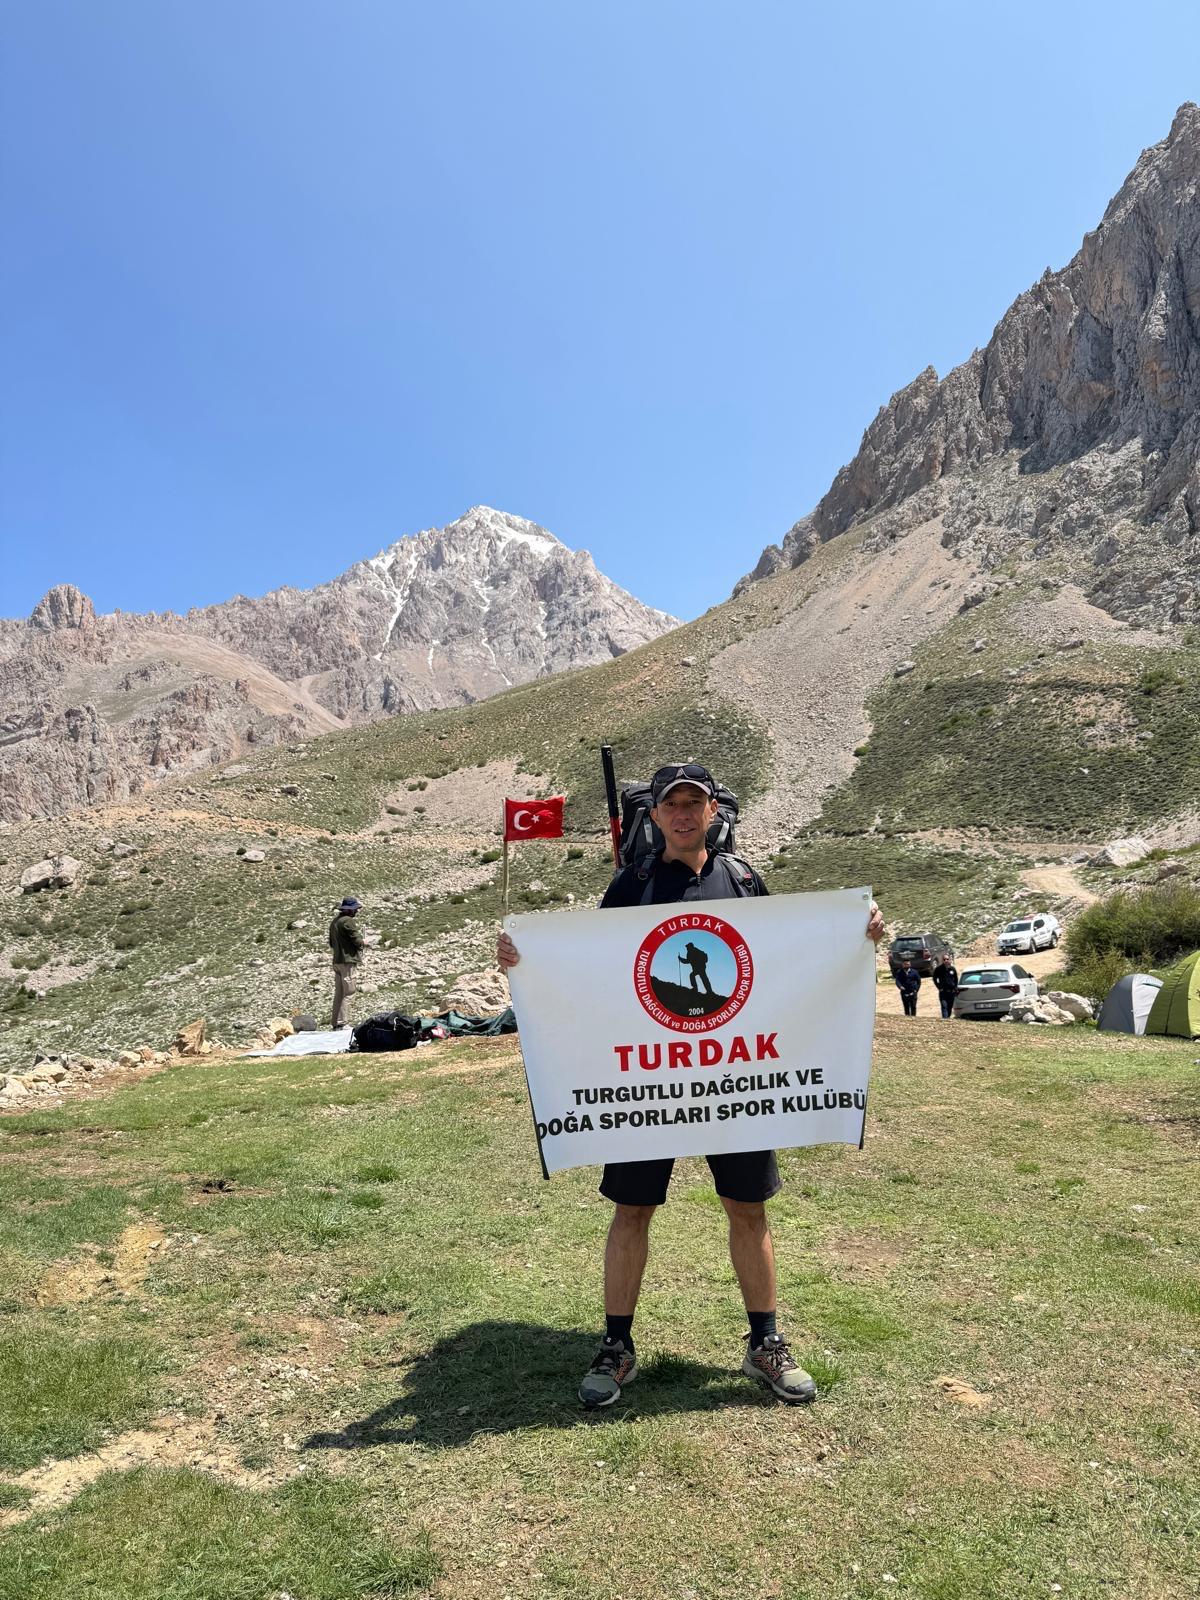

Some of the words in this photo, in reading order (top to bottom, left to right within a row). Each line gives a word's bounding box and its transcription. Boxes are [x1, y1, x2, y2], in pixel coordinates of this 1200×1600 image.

[658, 917, 724, 936] TURDAK
[637, 950, 651, 994] TURGUTLU
[736, 979, 750, 1001] SPOR
[641, 994, 671, 1025] DAĞCILIK
[688, 1008, 705, 1016] 2004
[708, 1001, 741, 1028] SPORLARI
[682, 1019, 707, 1031] DOĞA
[614, 1032, 780, 1072] TURDAK
[572, 1082, 684, 1106] TURGUTLU
[691, 1071, 790, 1098] DAĞCILIK
[795, 1068, 824, 1086] VE
[537, 1110, 594, 1140] DOĞA
[600, 1106, 711, 1130] SPORLARI
[716, 1099, 775, 1121] SPOR
[781, 1088, 865, 1113] KULÜBÜ
